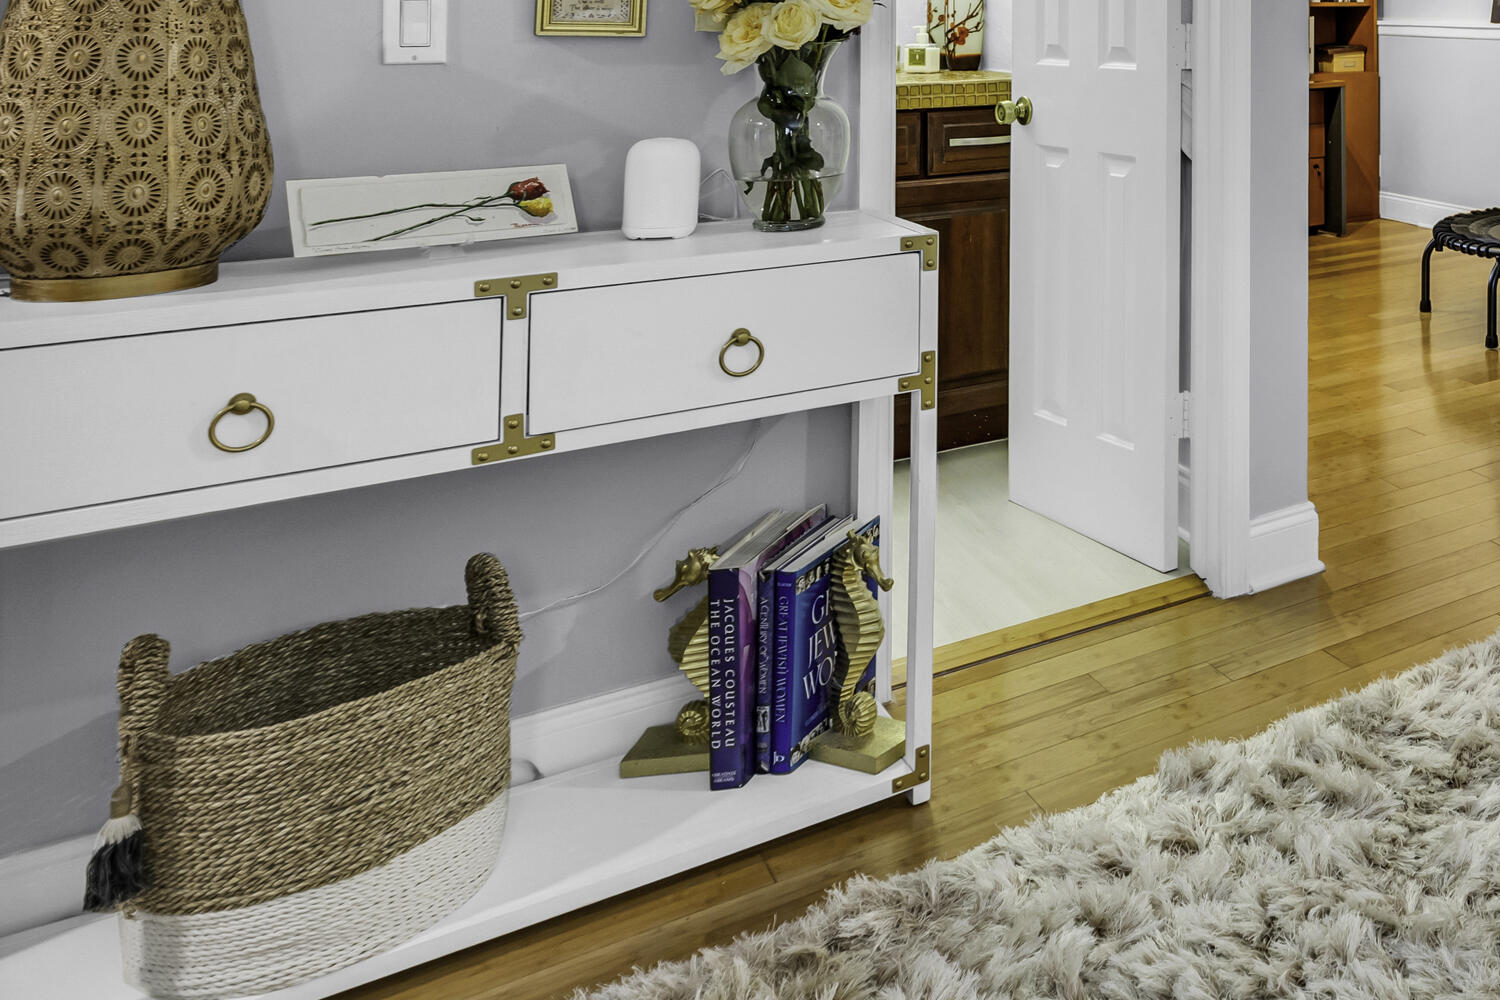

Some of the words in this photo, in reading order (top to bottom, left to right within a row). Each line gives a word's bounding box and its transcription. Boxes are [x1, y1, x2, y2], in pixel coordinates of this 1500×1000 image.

[711, 600, 721, 628] THE
[723, 599, 735, 662] JACQUES
[759, 604, 768, 644] CENTURY
[777, 596, 789, 631] GREAT
[710, 635, 720, 688] OCEAN
[776, 635, 788, 674] JEWISH
[758, 661, 768, 694] WOMEN
[723, 669, 735, 747] COUSTEAU
[775, 677, 787, 723] WOMEN
[711, 696, 721, 750] WORLD
